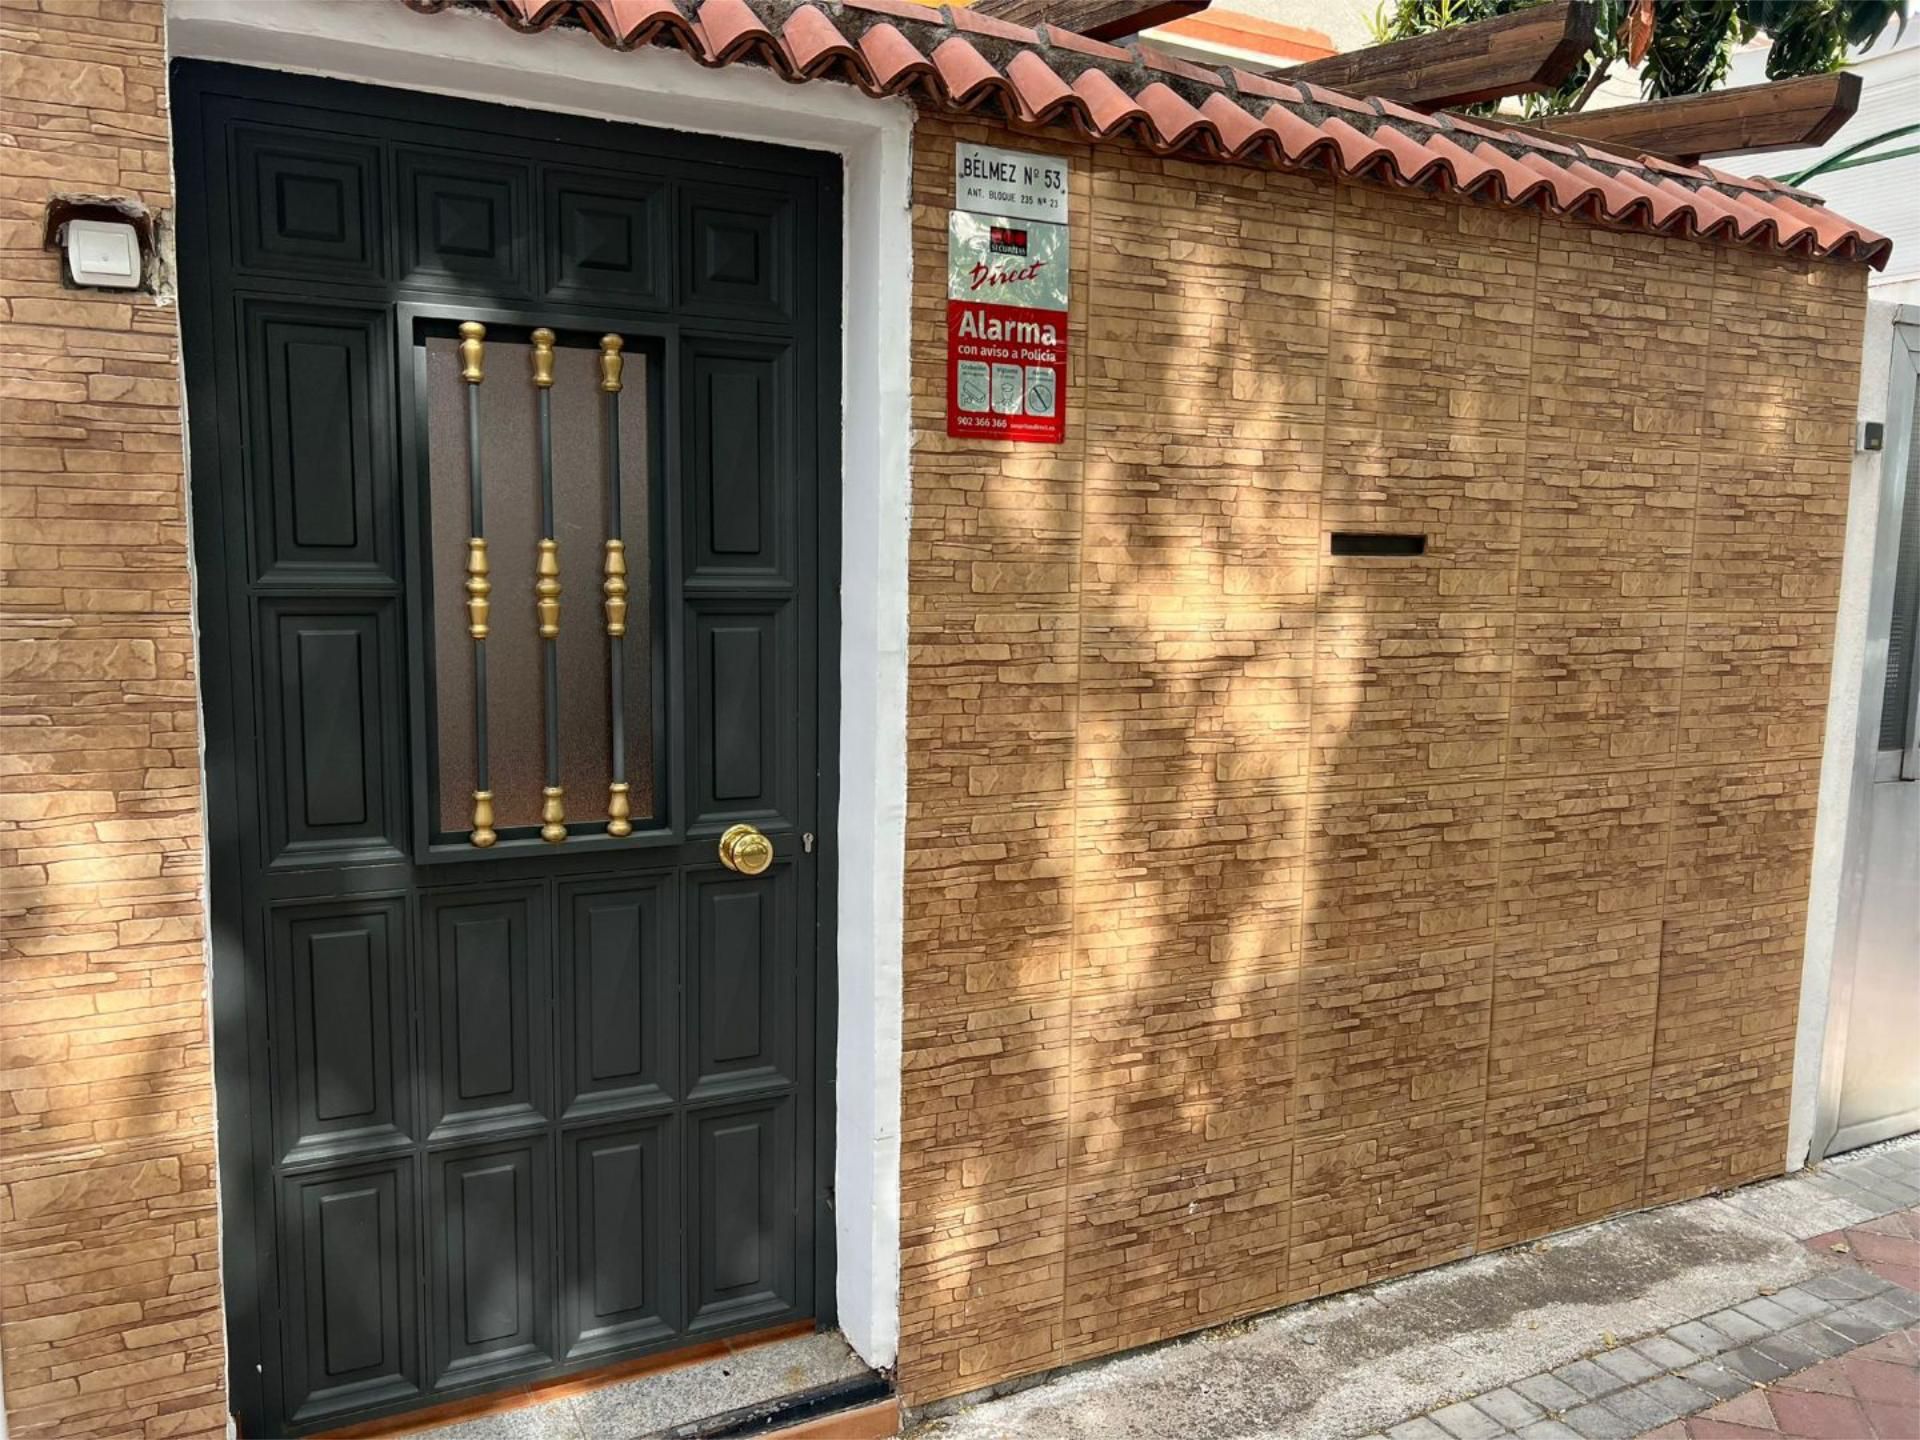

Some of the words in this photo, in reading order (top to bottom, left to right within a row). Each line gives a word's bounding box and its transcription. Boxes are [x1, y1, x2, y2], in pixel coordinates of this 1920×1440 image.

[964, 152, 1017, 183] BÉLMEZ
[1044, 169, 1061, 189] 53
[967, 187, 985, 199] ANT.
[988, 190, 1016, 203] BLOQUE
[969, 260, 1048, 291] Direct
[958, 309, 1057, 346] Alarma
[958, 344, 978, 355] con
[980, 346, 1009, 358] aviso
[1011, 349, 1019, 359] a
[957, 416, 973, 426] 902
[975, 417, 990, 427] 366
